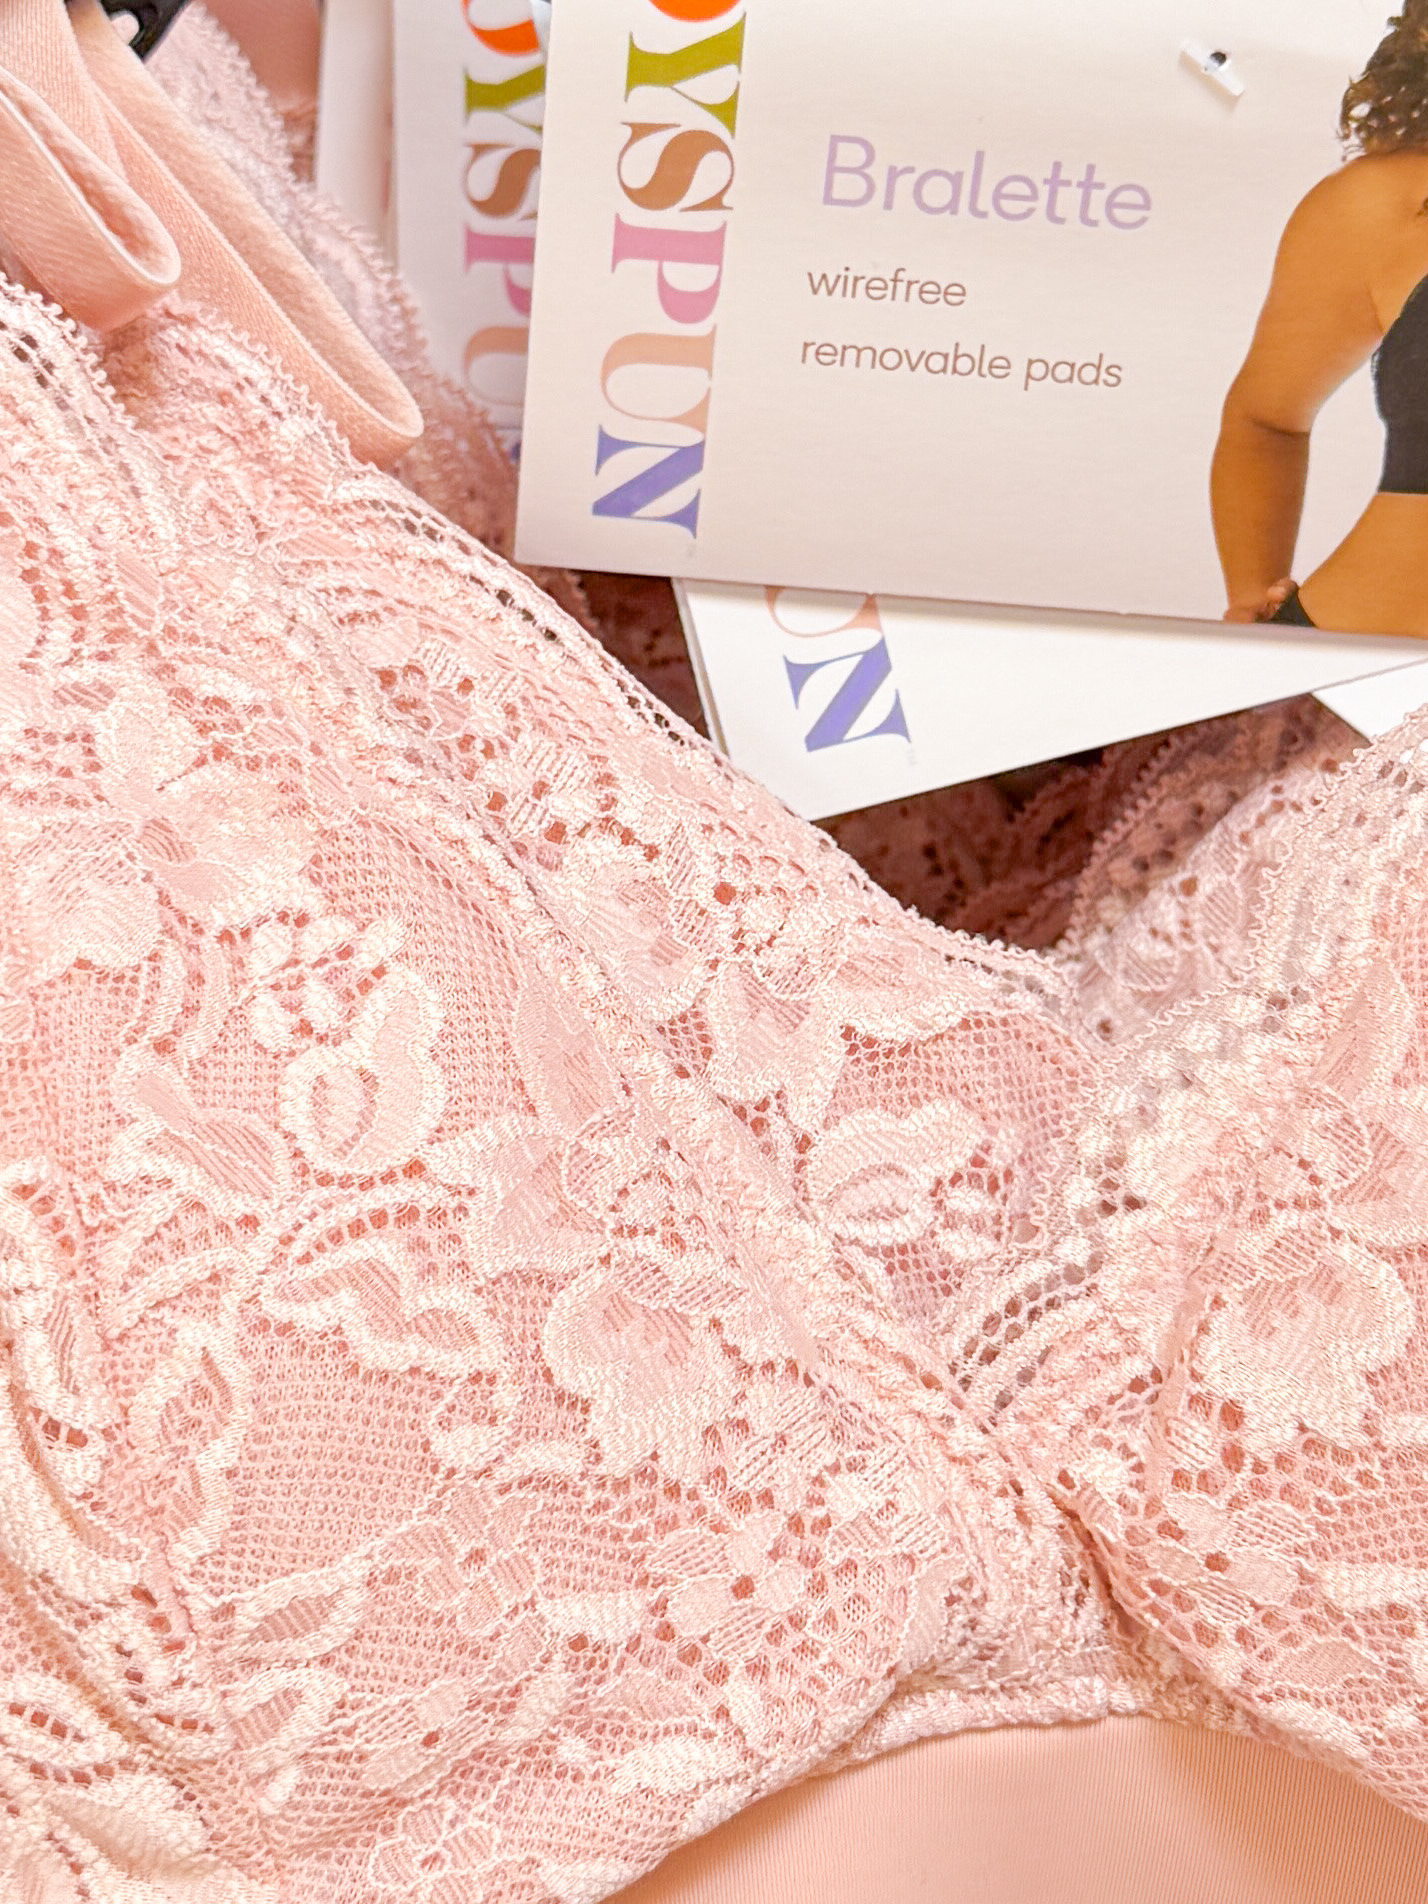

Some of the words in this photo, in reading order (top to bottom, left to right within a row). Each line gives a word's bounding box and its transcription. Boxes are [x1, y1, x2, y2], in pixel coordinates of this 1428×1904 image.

[822, 133, 1152, 231] Bralette
[806, 266, 967, 307] wirefree
[800, 341, 1012, 380] removable
[1023, 352, 1123, 392] pads
